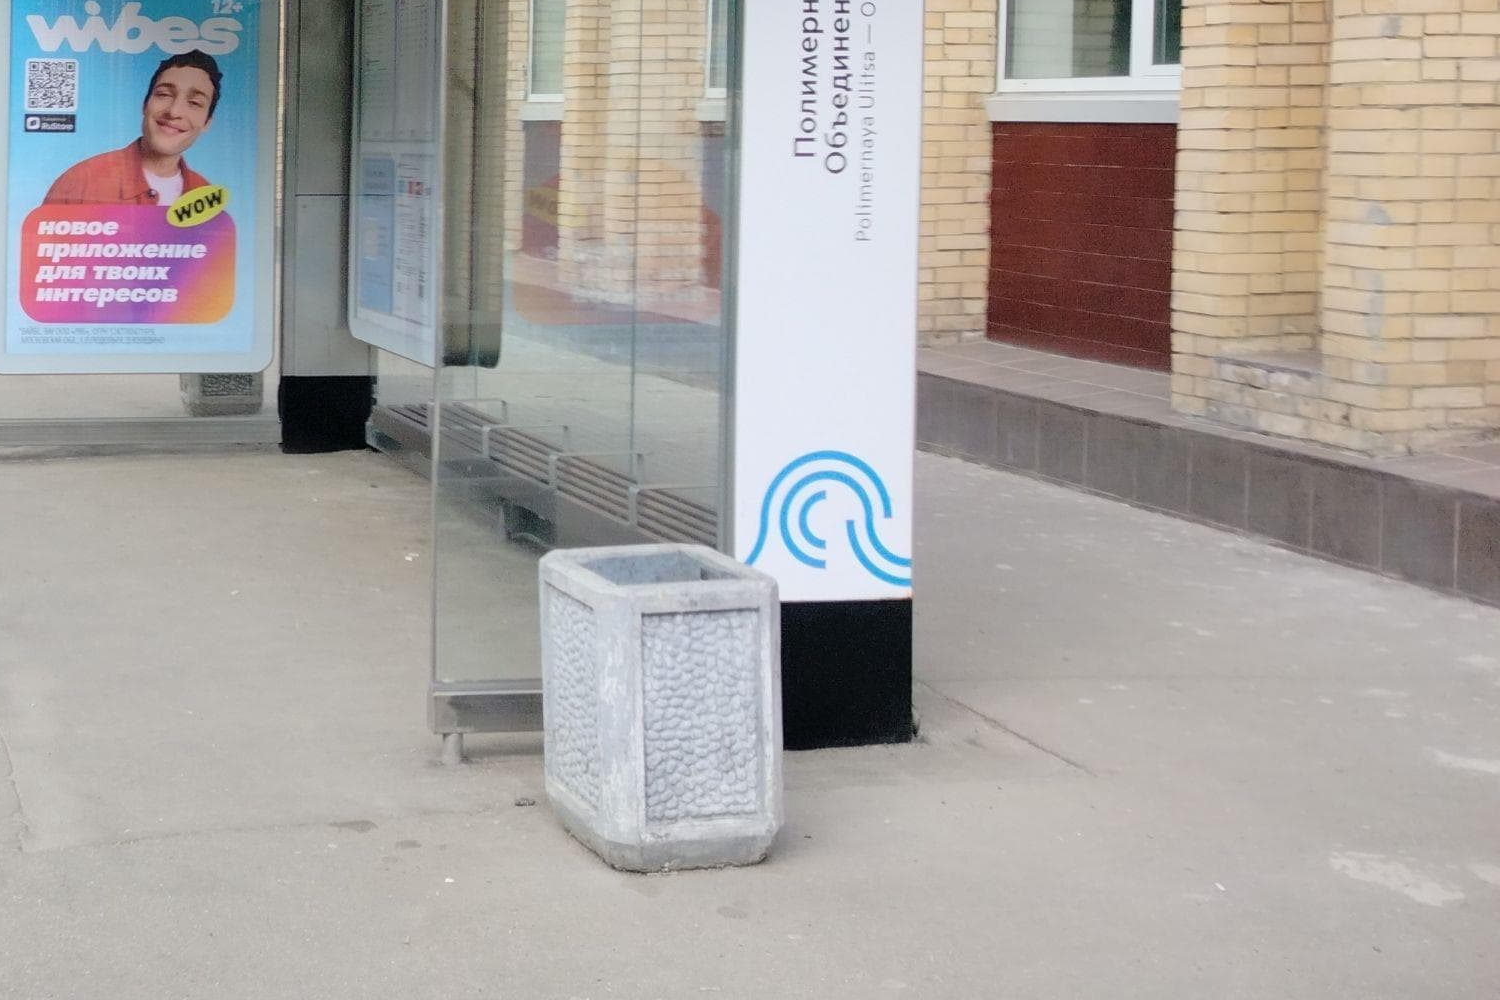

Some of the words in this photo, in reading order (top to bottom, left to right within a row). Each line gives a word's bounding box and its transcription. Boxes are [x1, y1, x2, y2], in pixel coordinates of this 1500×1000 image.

[857, 51, 877, 110] Ulitsa
[854, 116, 879, 242] Polimernaya
[173, 188, 223, 223] WOW
[37, 221, 119, 236] новое
[36, 243, 208, 263] приложение
[35, 266, 87, 283] для
[93, 266, 171, 280] твоих
[35, 287, 178, 308] интересов
